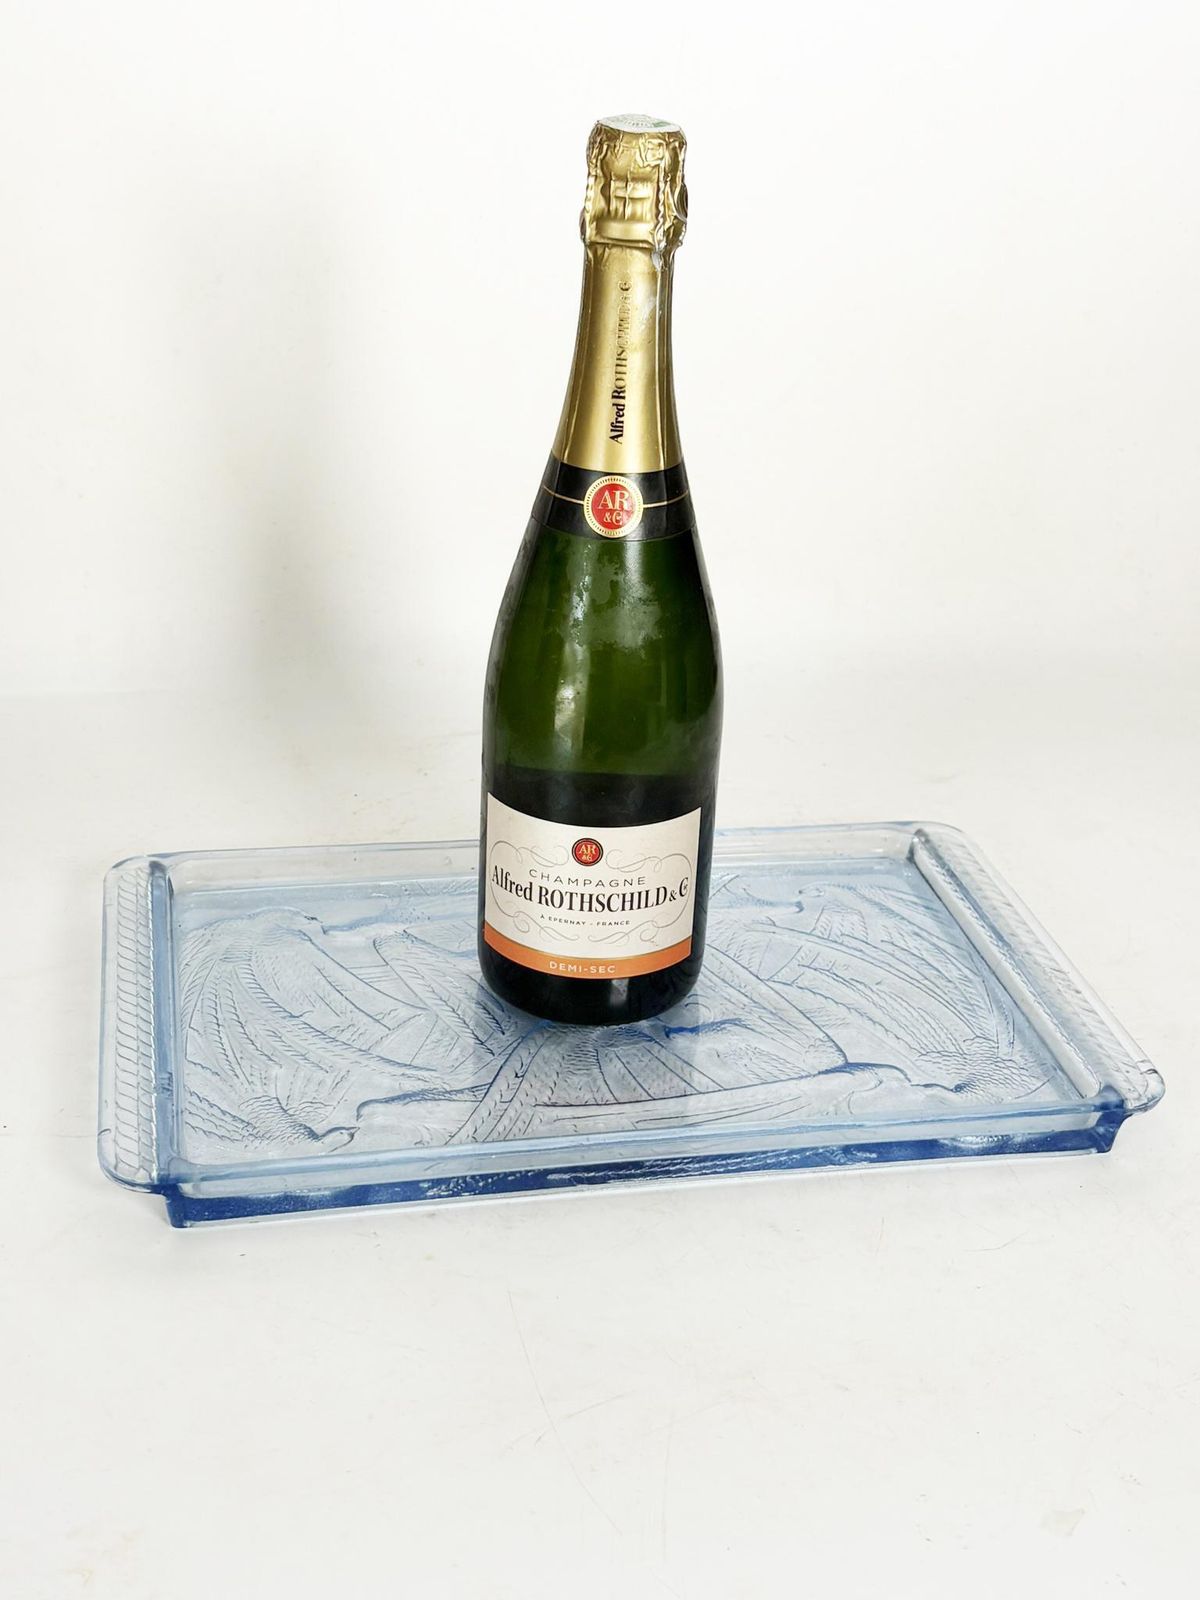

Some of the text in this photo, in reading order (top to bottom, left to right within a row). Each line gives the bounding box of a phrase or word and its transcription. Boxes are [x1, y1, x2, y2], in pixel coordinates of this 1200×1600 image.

[609, 404, 626, 444] Alfred
[597, 490, 631, 510] AR
[579, 844, 596, 854] AR
[528, 868, 647, 888] CHAMPAGNE
[491, 864, 534, 902] Alfred
[538, 884, 668, 913] ROTHSCHILD
[669, 889, 677, 903] &
[548, 916, 586, 926] EPERNAY
[549, 960, 616, 974] DEMI-SEC
